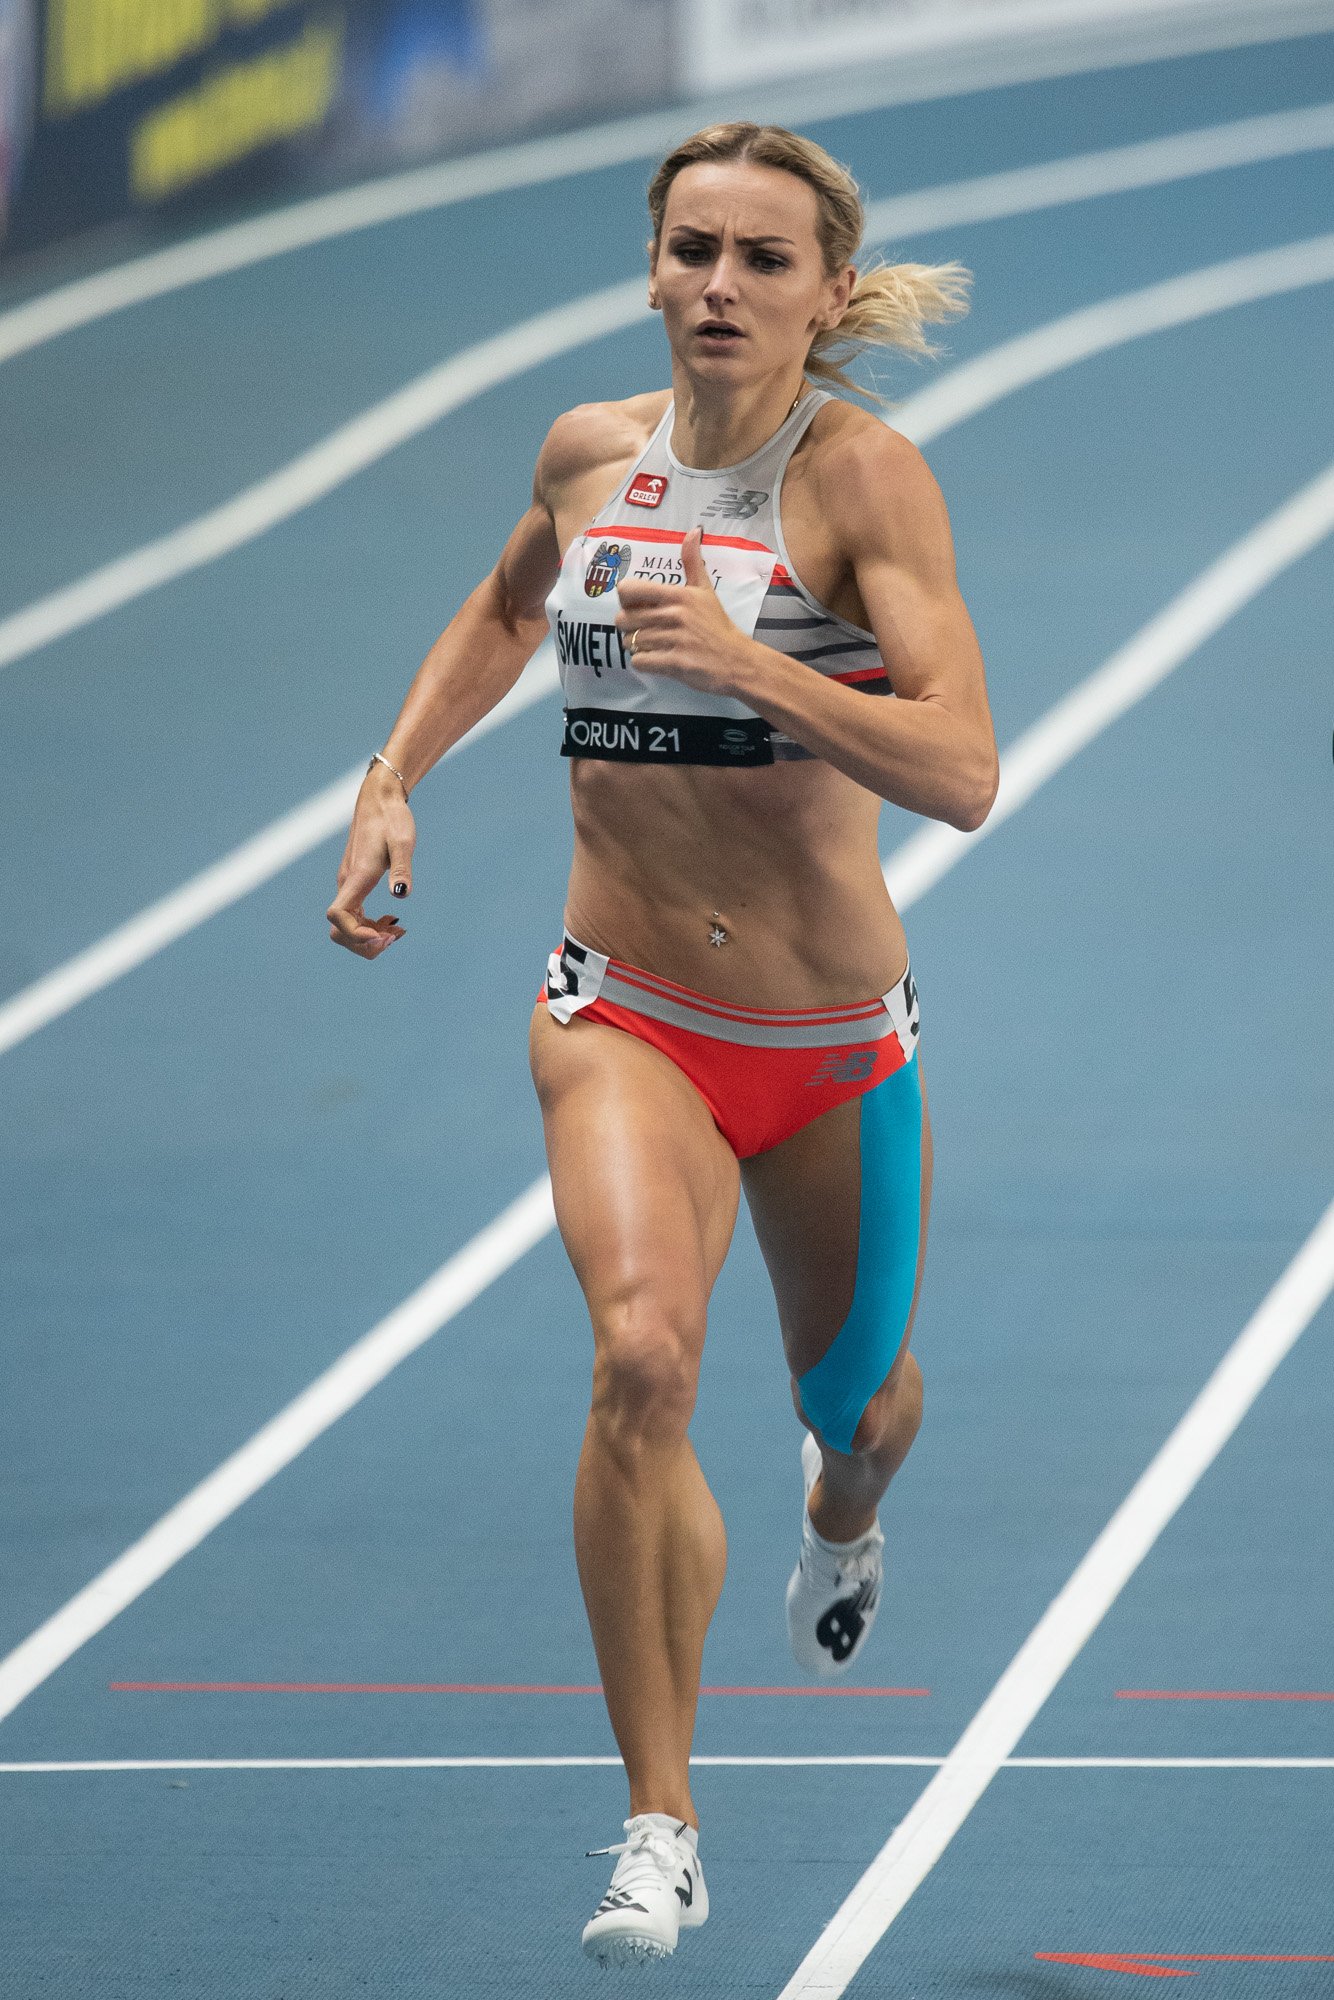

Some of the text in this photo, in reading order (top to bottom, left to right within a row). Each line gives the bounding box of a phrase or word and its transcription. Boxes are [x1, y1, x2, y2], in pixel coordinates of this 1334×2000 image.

[632, 491, 658, 502] ORLEN
[641, 556, 705, 571] MIAS
[648, 726, 681, 752] 21
